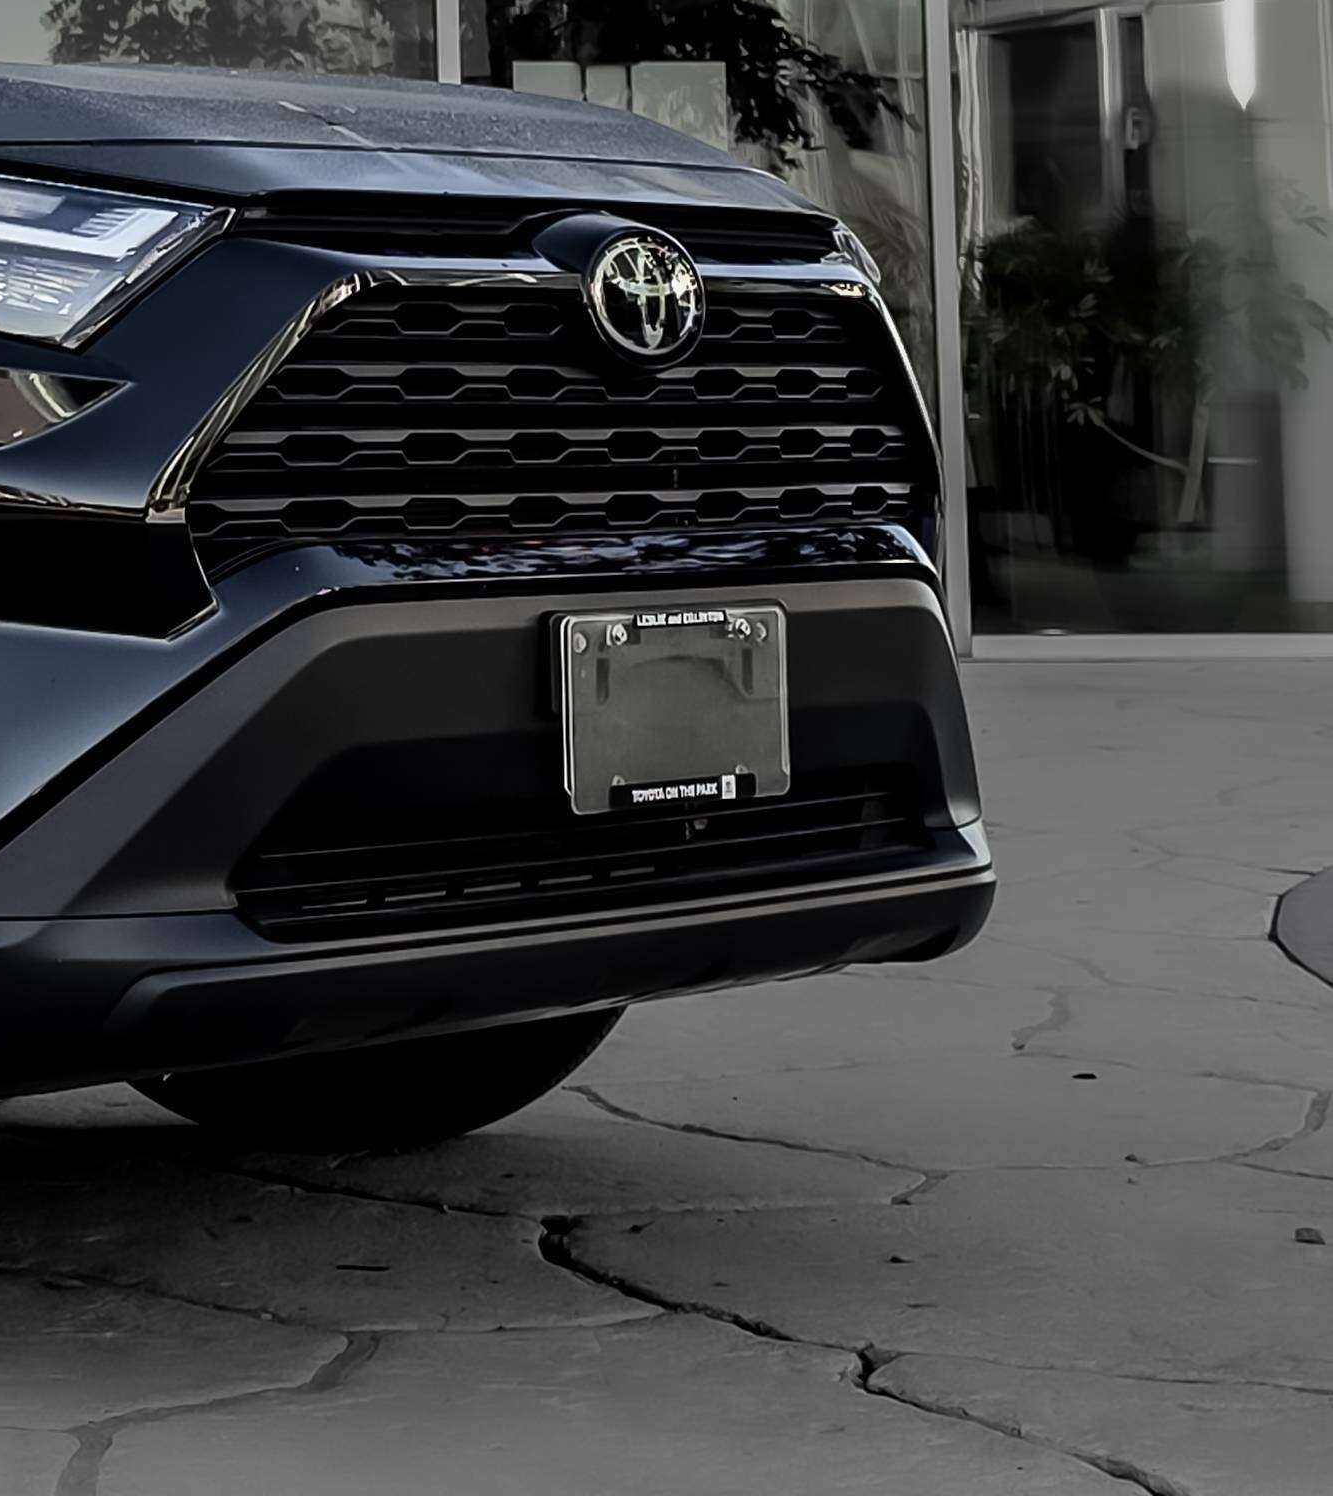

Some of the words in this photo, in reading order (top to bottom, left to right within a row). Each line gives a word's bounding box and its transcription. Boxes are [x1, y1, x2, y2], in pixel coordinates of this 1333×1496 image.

[632, 788, 665, 802] TOYOTA
[666, 786, 678, 799] ON
[679, 784, 695, 798] THE
[696, 783, 717, 795] PARK
